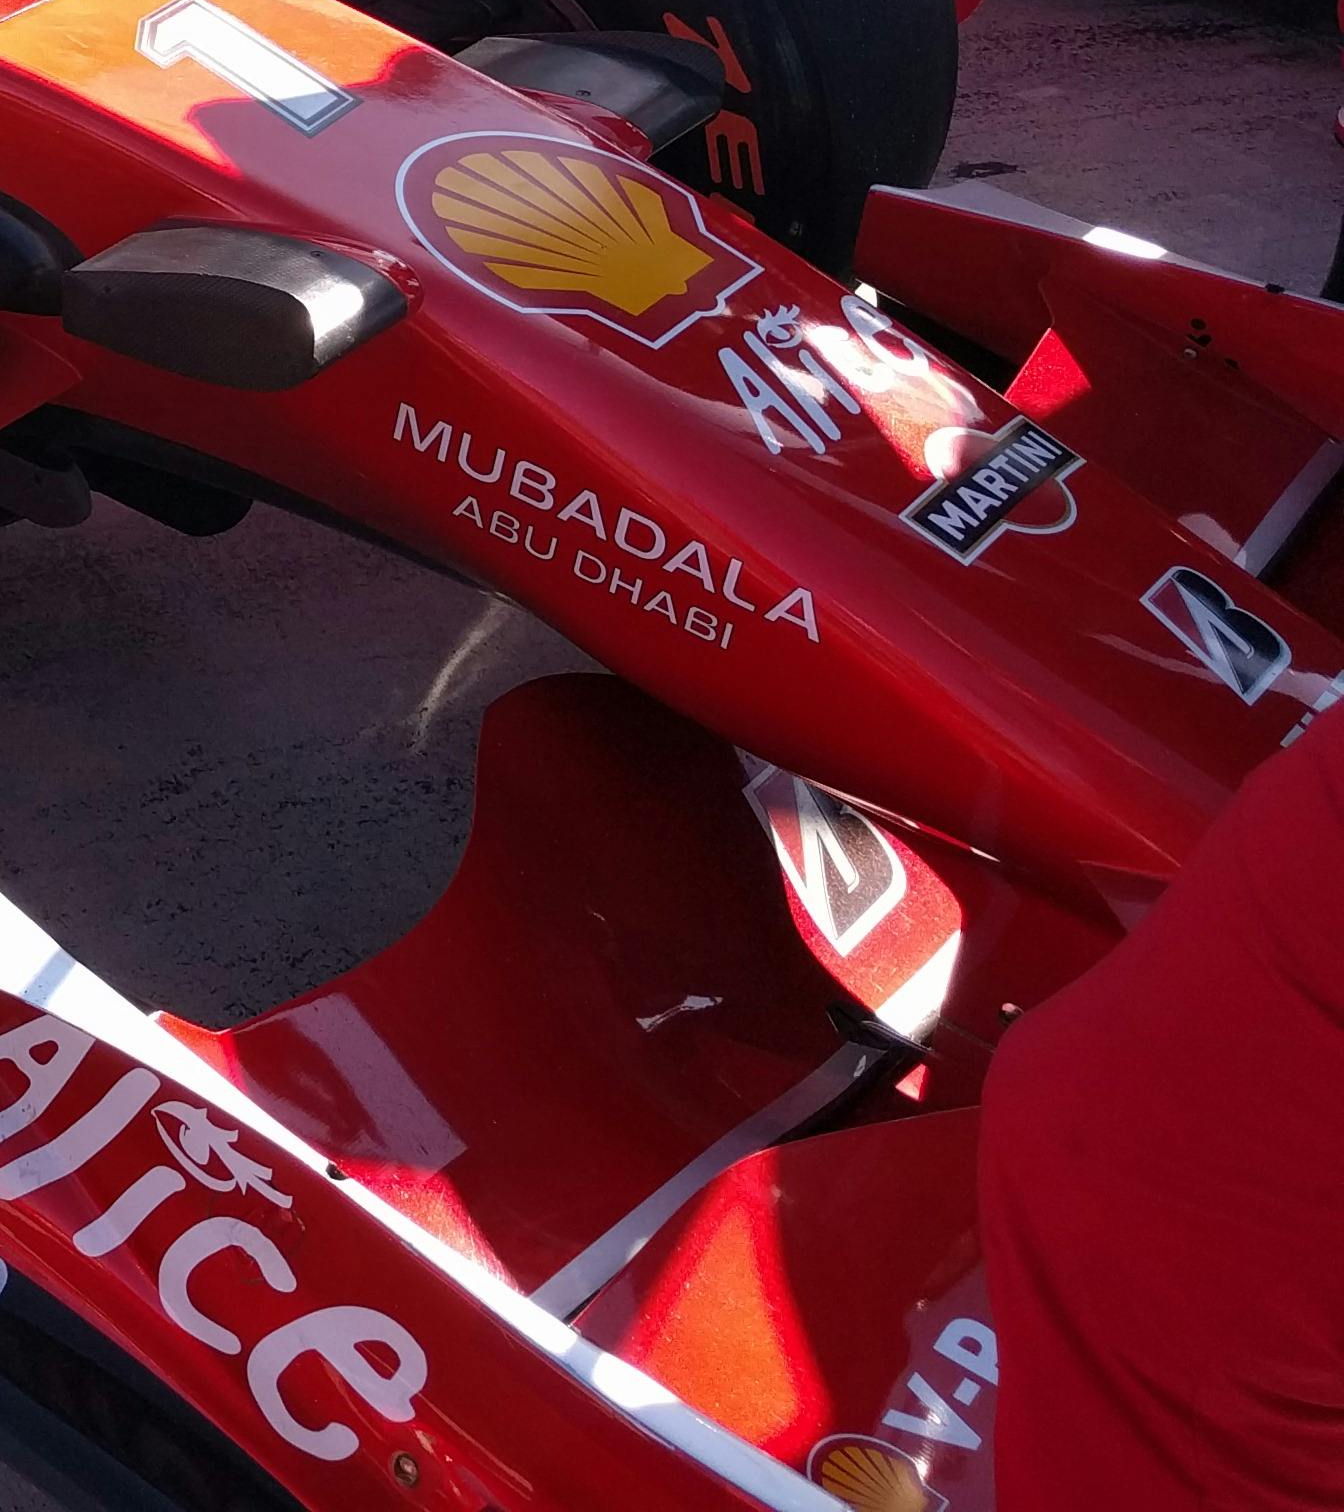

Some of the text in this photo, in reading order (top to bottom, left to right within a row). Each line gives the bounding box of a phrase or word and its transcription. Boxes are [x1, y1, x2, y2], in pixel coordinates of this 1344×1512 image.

[392, 401, 821, 644] MUBADALA
[926, 429, 1064, 542] MARTINI
[451, 494, 735, 651] ABU DHABI
